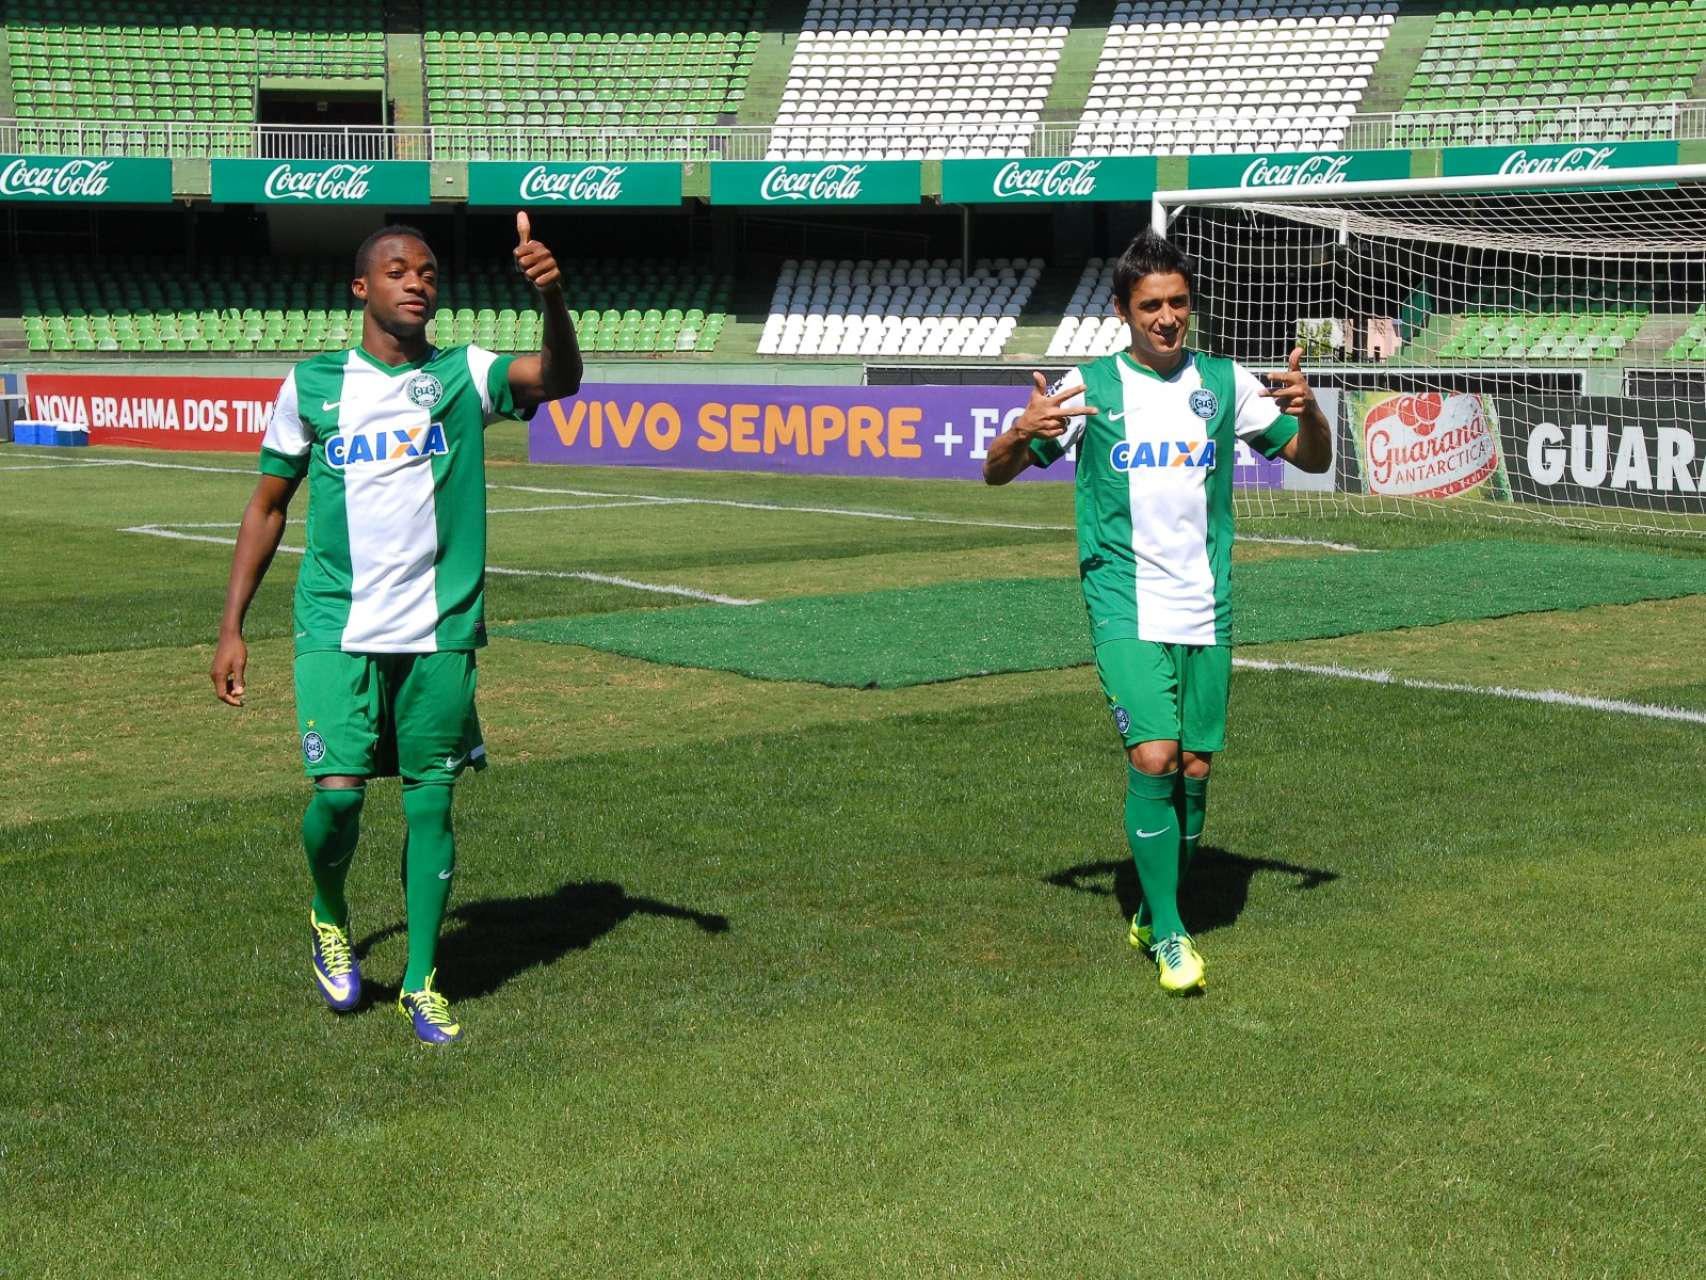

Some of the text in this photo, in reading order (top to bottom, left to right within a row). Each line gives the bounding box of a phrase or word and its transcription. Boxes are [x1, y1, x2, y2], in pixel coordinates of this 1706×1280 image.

[0, 158, 114, 196] Coca-Cola
[993, 160, 1101, 198] Coca-Cola
[1498, 146, 1617, 176] Coca-Cl
[264, 164, 374, 200] Coca-Cola
[519, 165, 627, 201] Coca-Cola
[760, 164, 867, 201] Coca-Cola
[35, 395, 89, 425] NOVA
[91, 396, 180, 430] BRAHMA
[183, 400, 229, 433] DOS
[549, 401, 681, 449] VIVO
[698, 404, 922, 458] SEMPRE
[325, 422, 449, 469] CAIXA
[1111, 440, 1215, 471] CAIXA
[1395, 440, 1487, 485] ANTARCTICA
[1527, 422, 1706, 492] GUAR
